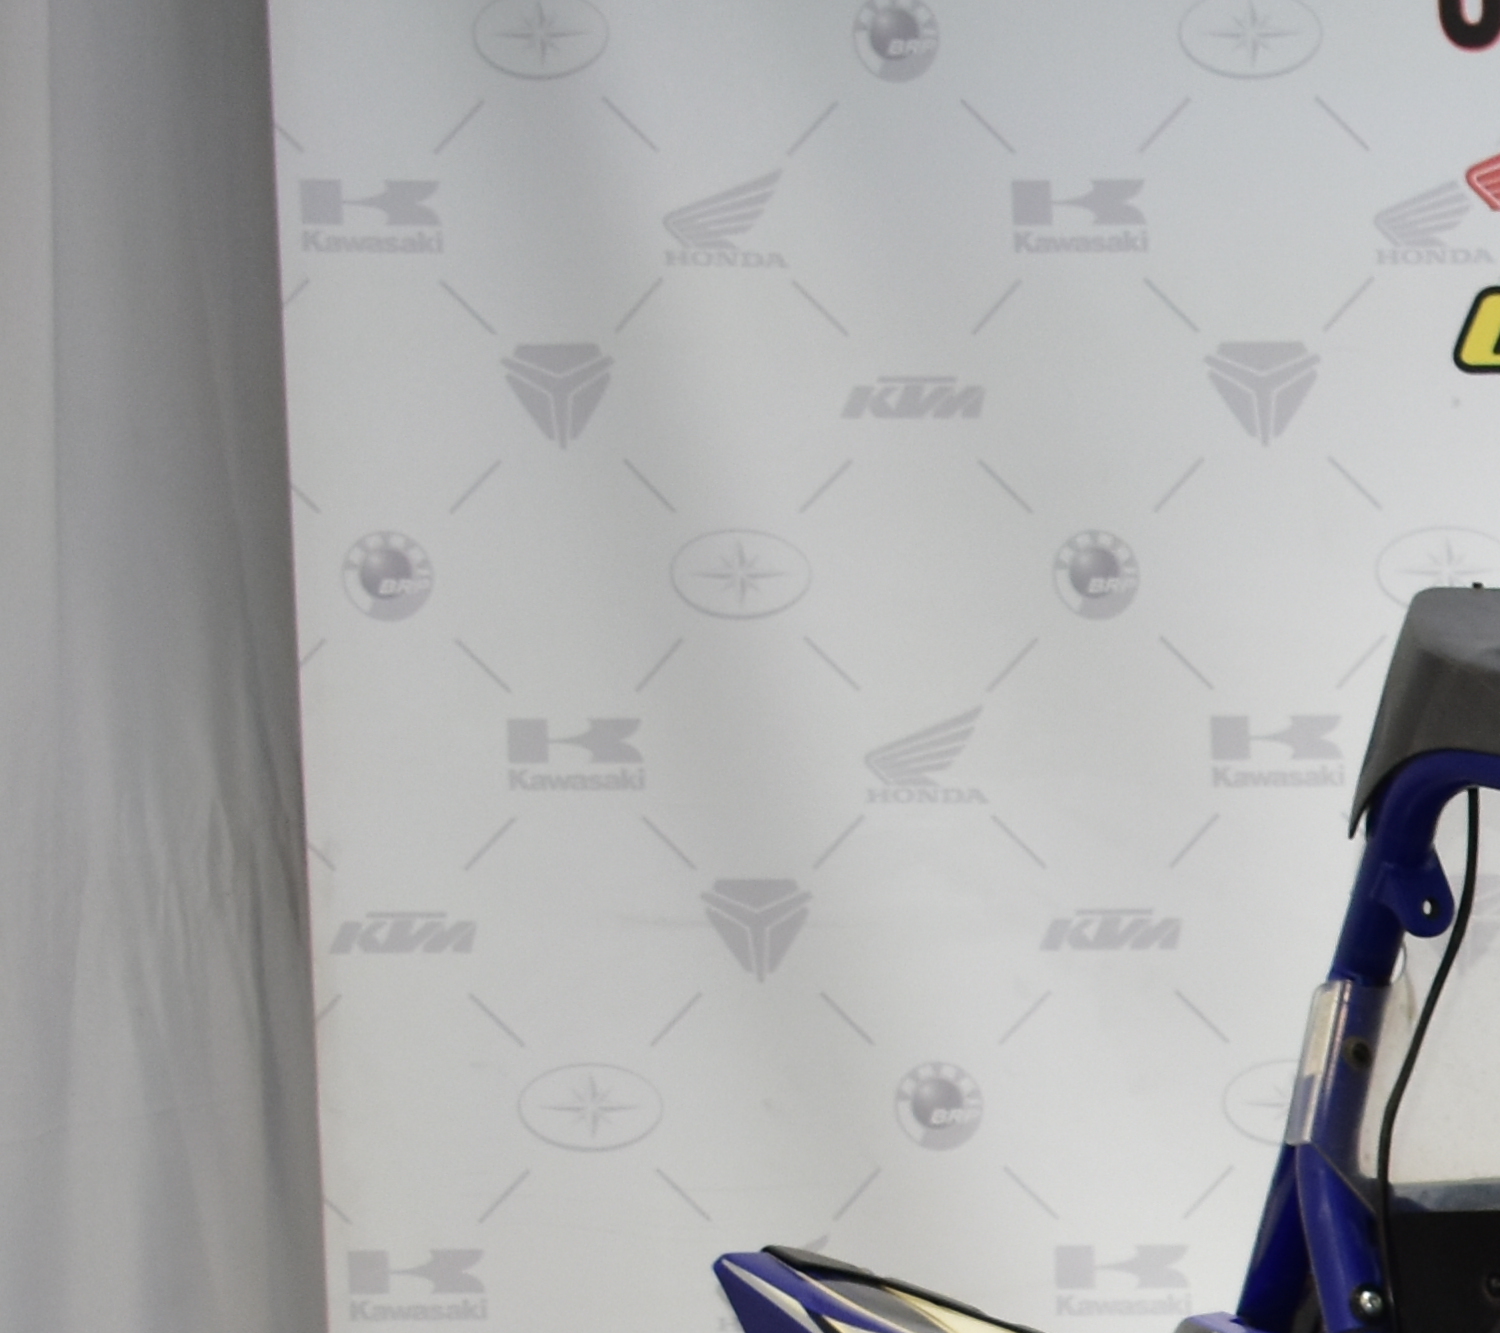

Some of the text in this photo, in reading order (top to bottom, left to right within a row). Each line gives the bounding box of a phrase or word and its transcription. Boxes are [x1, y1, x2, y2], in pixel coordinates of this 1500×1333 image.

[301, 229, 443, 255] Kawasaki
[1013, 229, 1148, 255] Kawasaki
[664, 249, 787, 269] HONDA
[1375, 247, 1496, 265] HONDA
[842, 375, 985, 419] KTM
[508, 766, 646, 793] Kawasaki
[1213, 765, 1345, 789] Kawasaki
[866, 785, 988, 804] HONDA
[331, 911, 477, 955] KTM
[1040, 908, 1181, 951] KTM
[349, 1297, 488, 1321] Kawasaki
[1056, 1293, 1190, 1317] Kawasaki
